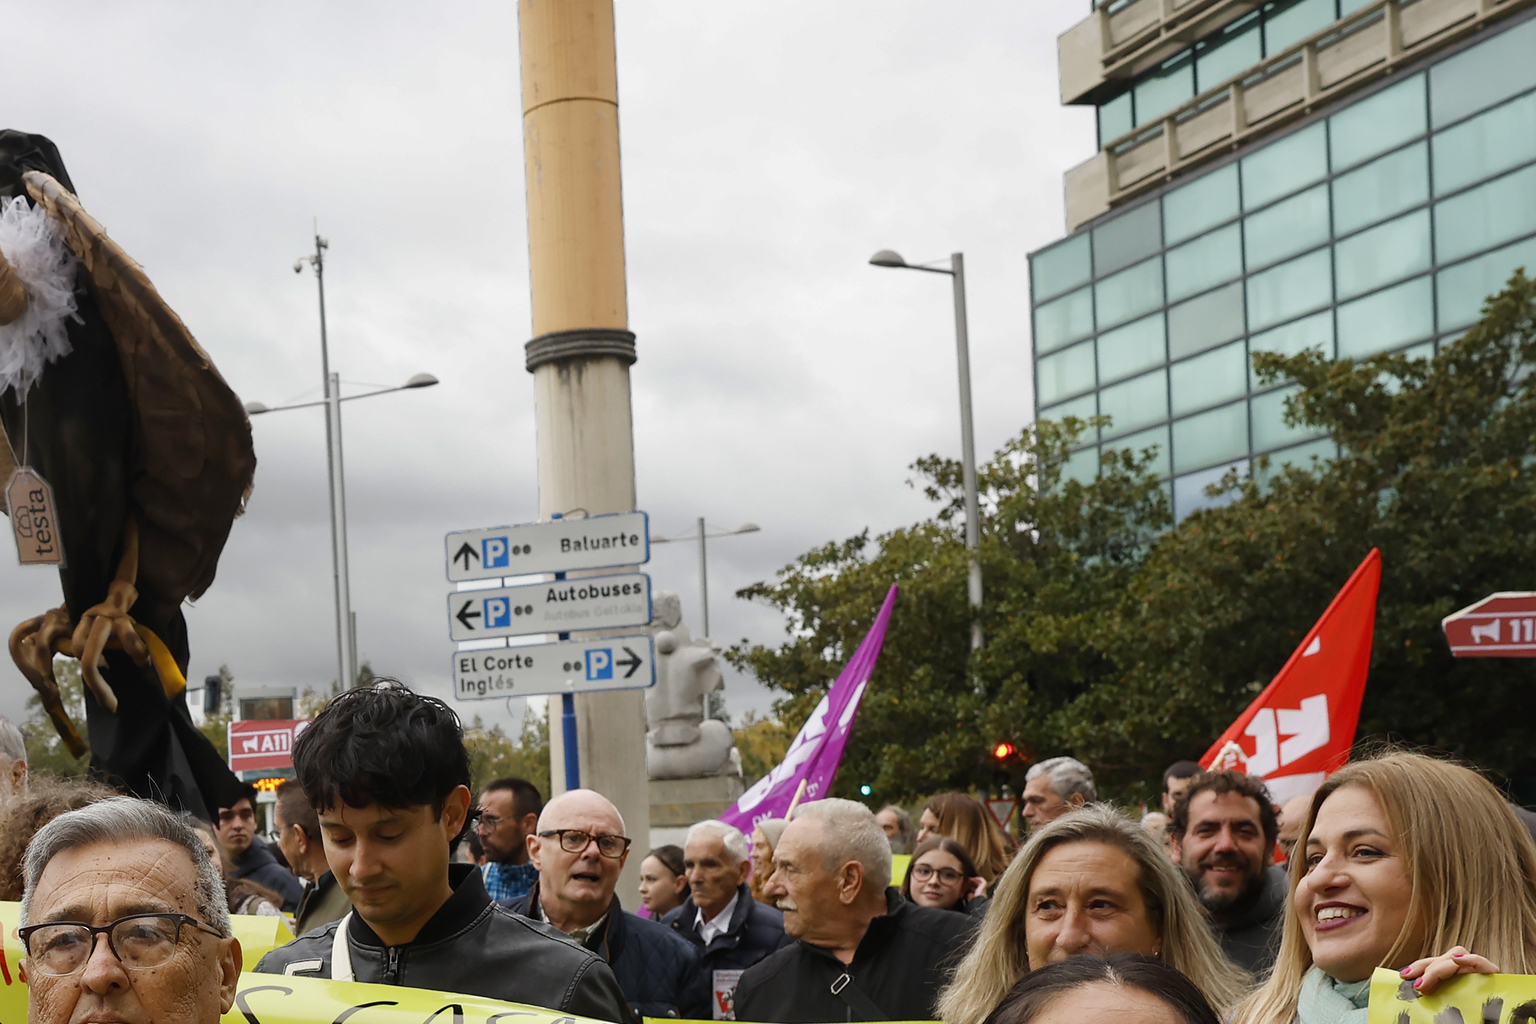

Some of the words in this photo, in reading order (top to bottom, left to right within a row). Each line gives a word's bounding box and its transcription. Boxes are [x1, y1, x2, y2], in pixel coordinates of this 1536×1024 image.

[29, 488, 54, 556] testa
[560, 532, 640, 554] Baluarte
[546, 580, 642, 603] Autobuses
[1508, 618, 1536, 643] 11
[460, 657, 477, 673] El
[484, 654, 534, 671] Corte
[461, 674, 514, 696] Inglés
